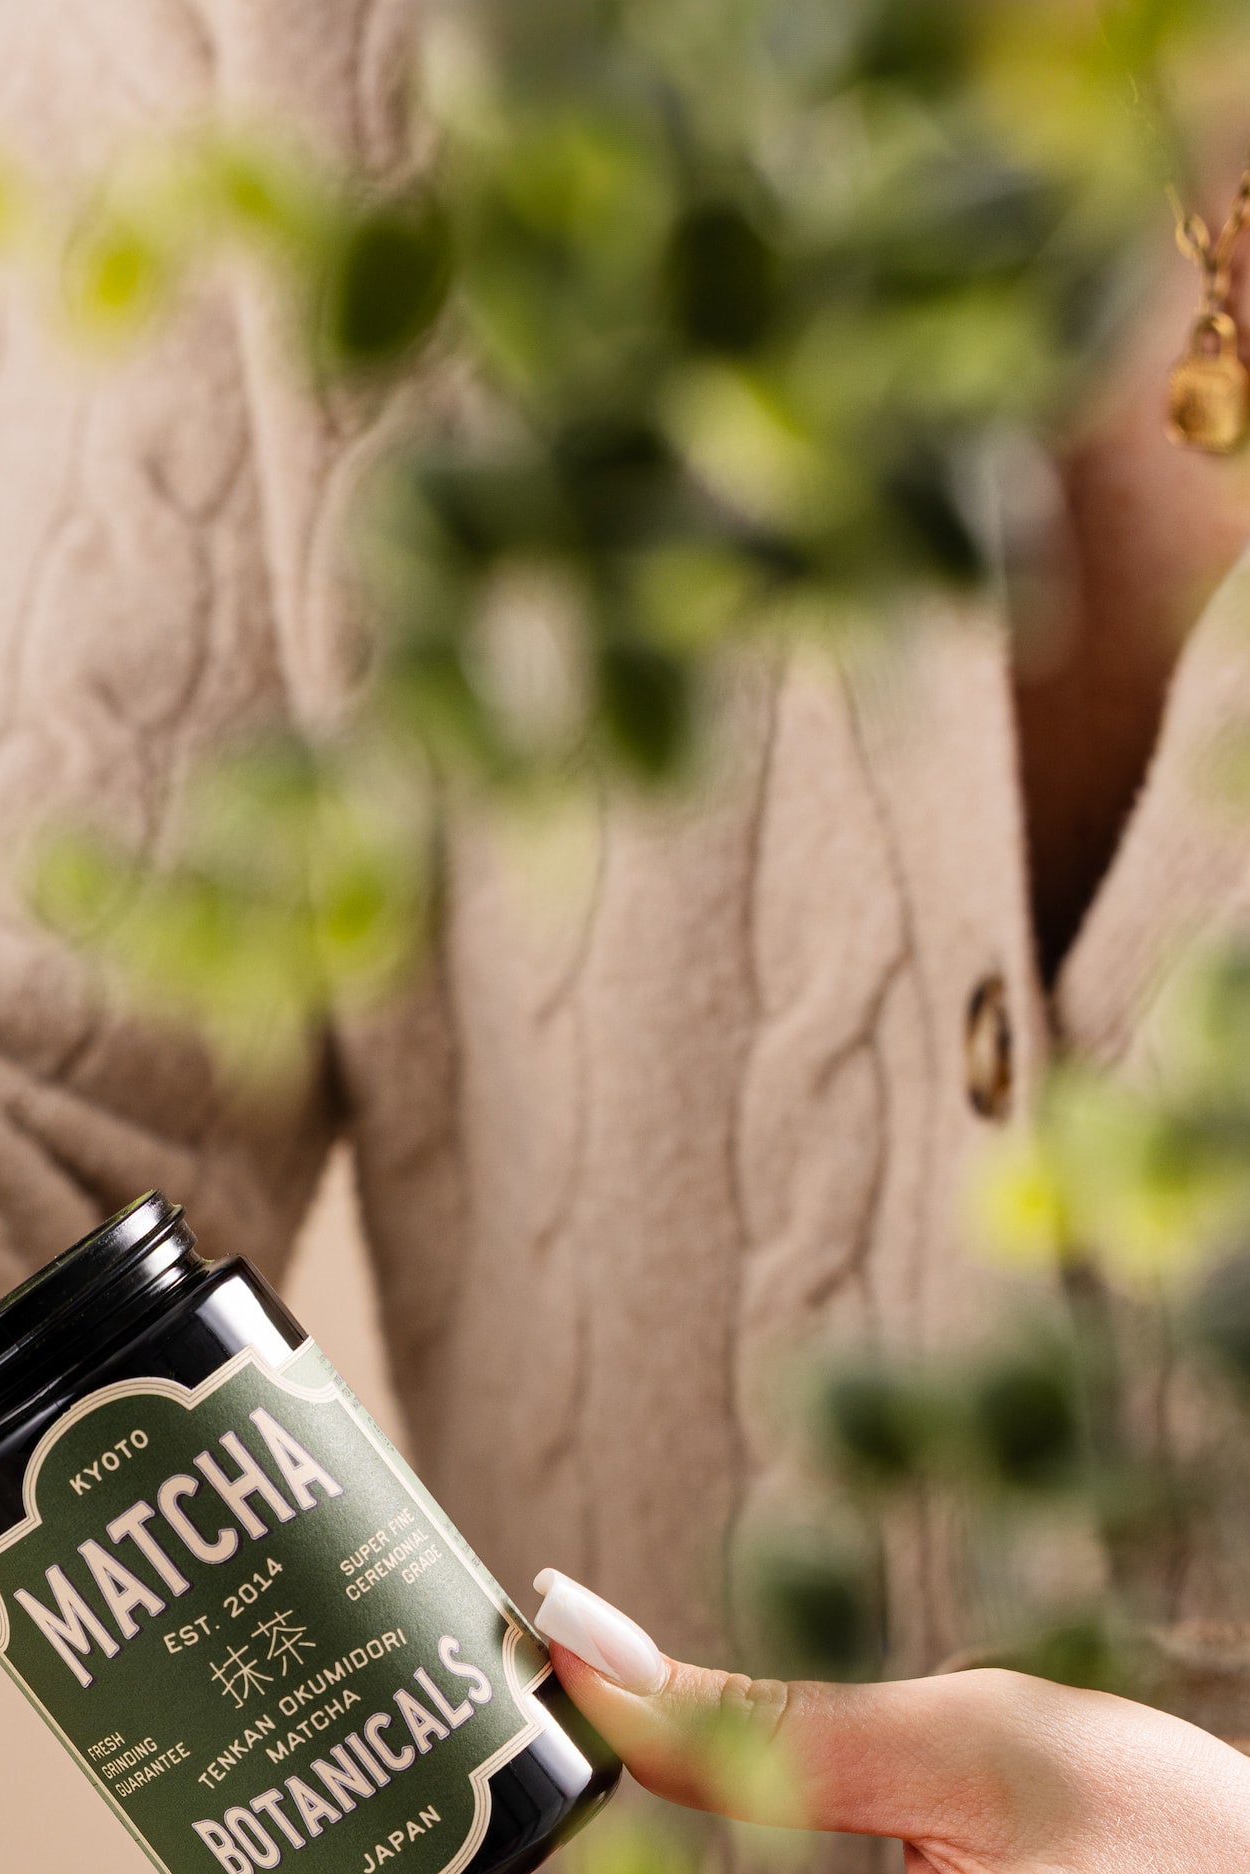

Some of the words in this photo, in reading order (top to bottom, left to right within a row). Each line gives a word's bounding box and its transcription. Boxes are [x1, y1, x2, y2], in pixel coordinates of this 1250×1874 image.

[68, 1429, 150, 1496] KYOTO
[13, 1407, 344, 1690] MATCHA
[340, 1531, 390, 1576] SUPER
[388, 1508, 415, 1536] FINE
[345, 1528, 429, 1601] CEREMONIAL
[401, 1544, 443, 1584] GRADE
[163, 1615, 221, 1654] EST.
[223, 1558, 284, 1618] 2014
[209, 1610, 317, 1709] 抹茶
[198, 1714, 276, 1789] TENKAN
[278, 1628, 407, 1716] OKUMIDORI
[265, 1689, 361, 1764] MATCHA
[87, 1732, 126, 1761] FRESH
[101, 1737, 158, 1779] GRINDING
[115, 1742, 190, 1797] GUARANTEE
[362, 1804, 442, 1874] JAPAN
